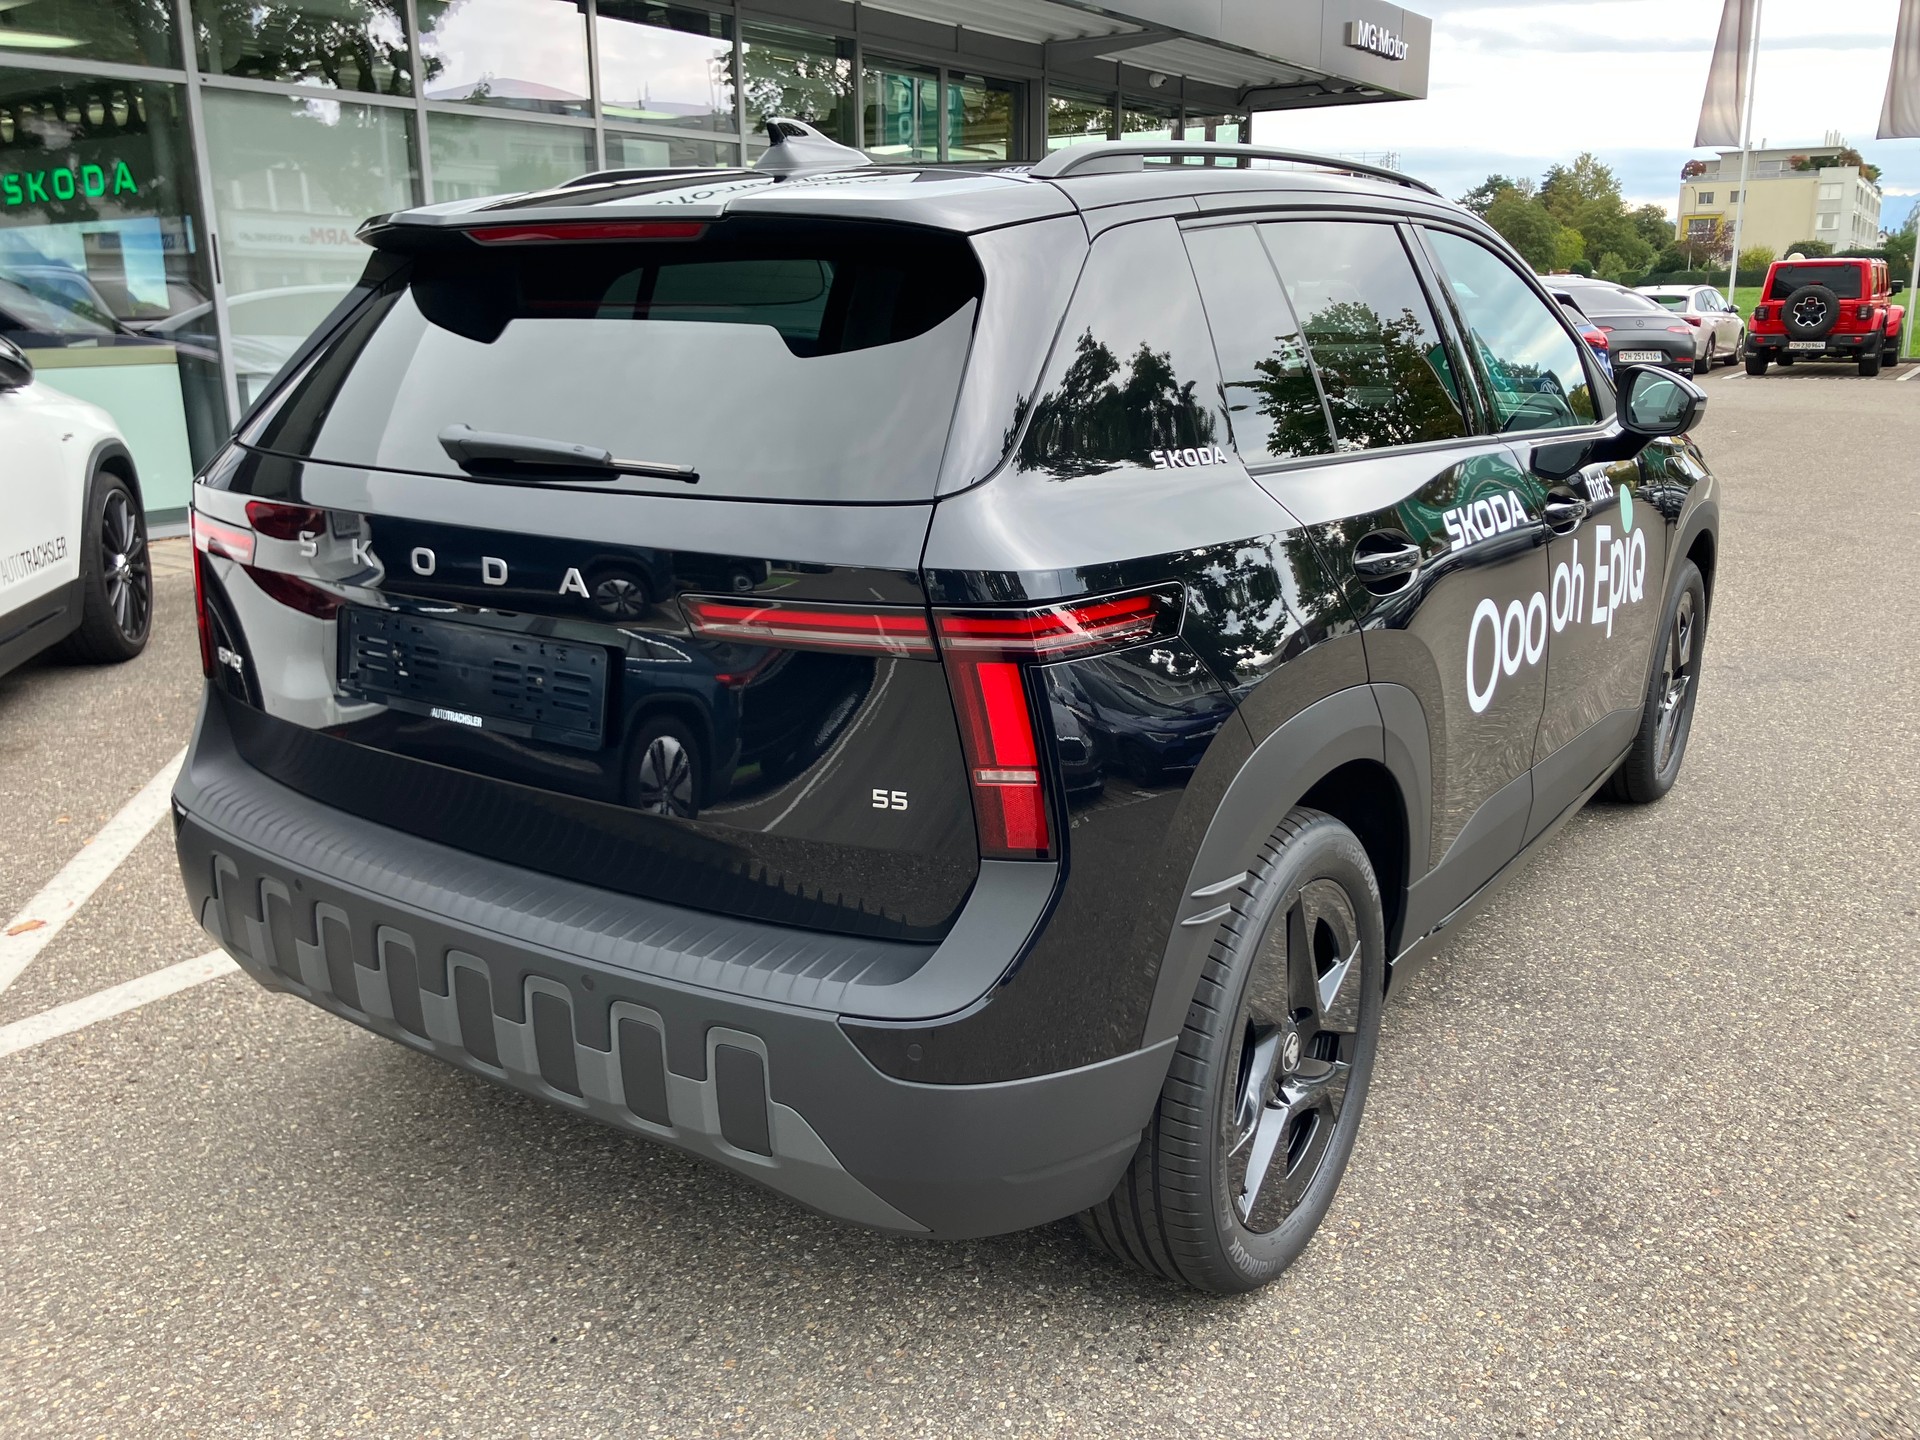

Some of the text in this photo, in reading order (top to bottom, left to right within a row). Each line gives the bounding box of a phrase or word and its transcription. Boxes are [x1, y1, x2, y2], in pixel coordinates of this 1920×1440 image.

[1358, 19, 1409, 60] MG Motor
[1584, 469, 1614, 502] that's
[872, 788, 908, 811] 55
